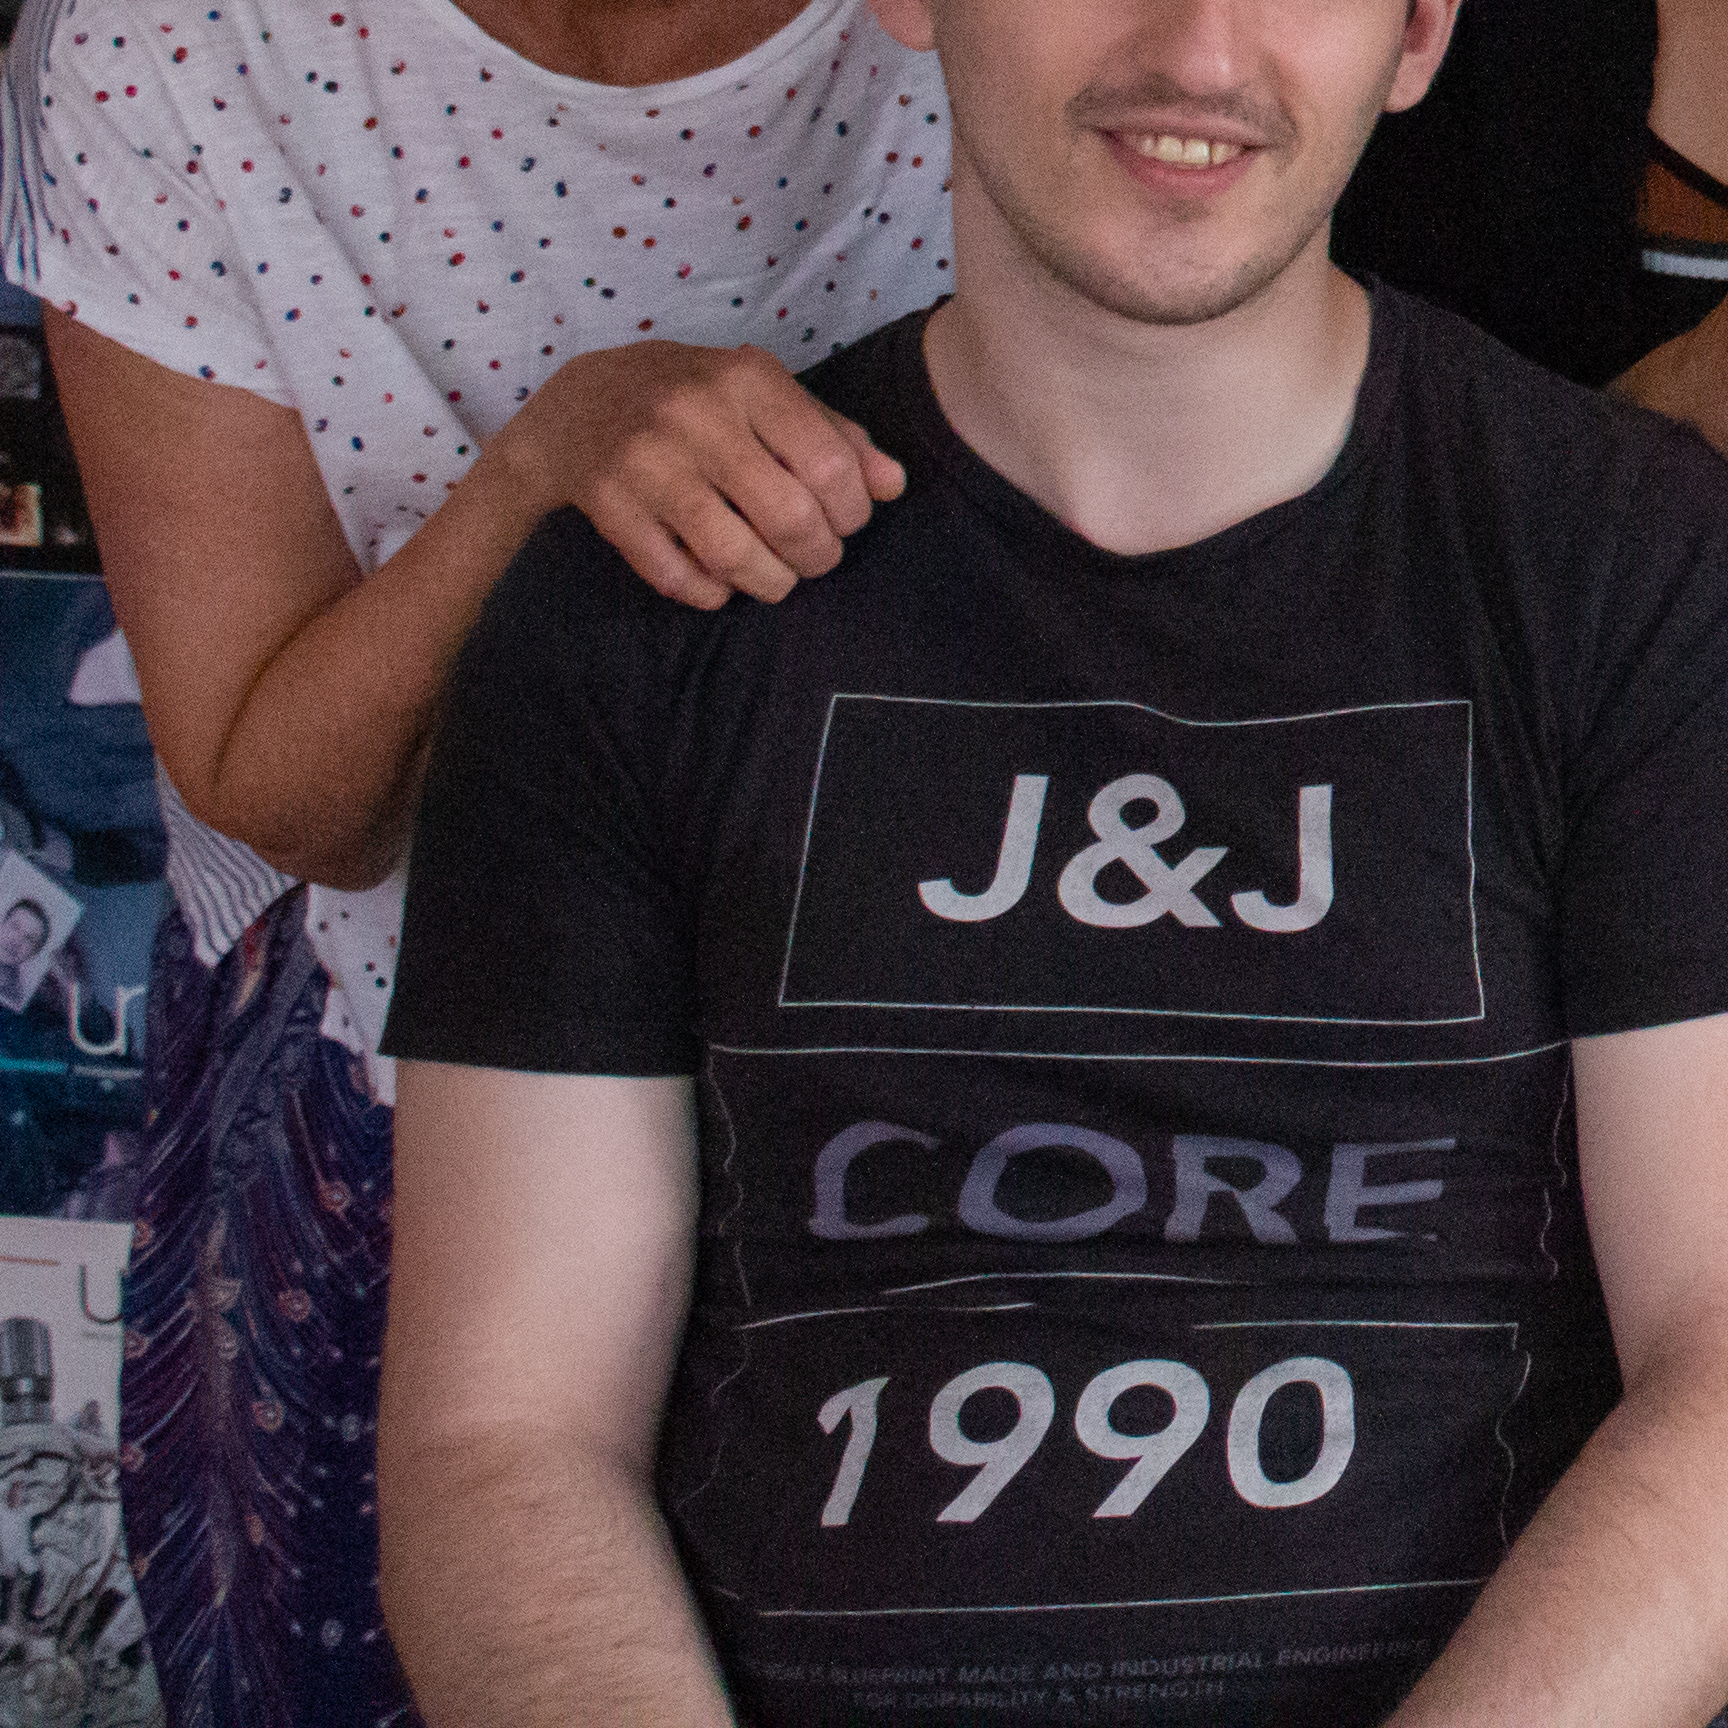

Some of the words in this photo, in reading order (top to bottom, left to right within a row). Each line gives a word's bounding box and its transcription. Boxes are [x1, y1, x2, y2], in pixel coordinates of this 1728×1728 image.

[917, 773, 1335, 934] J&J
[806, 1121, 1458, 1245] CORE
[817, 1356, 1355, 1529] 1990
[1043, 1660, 1102, 1682] AND
